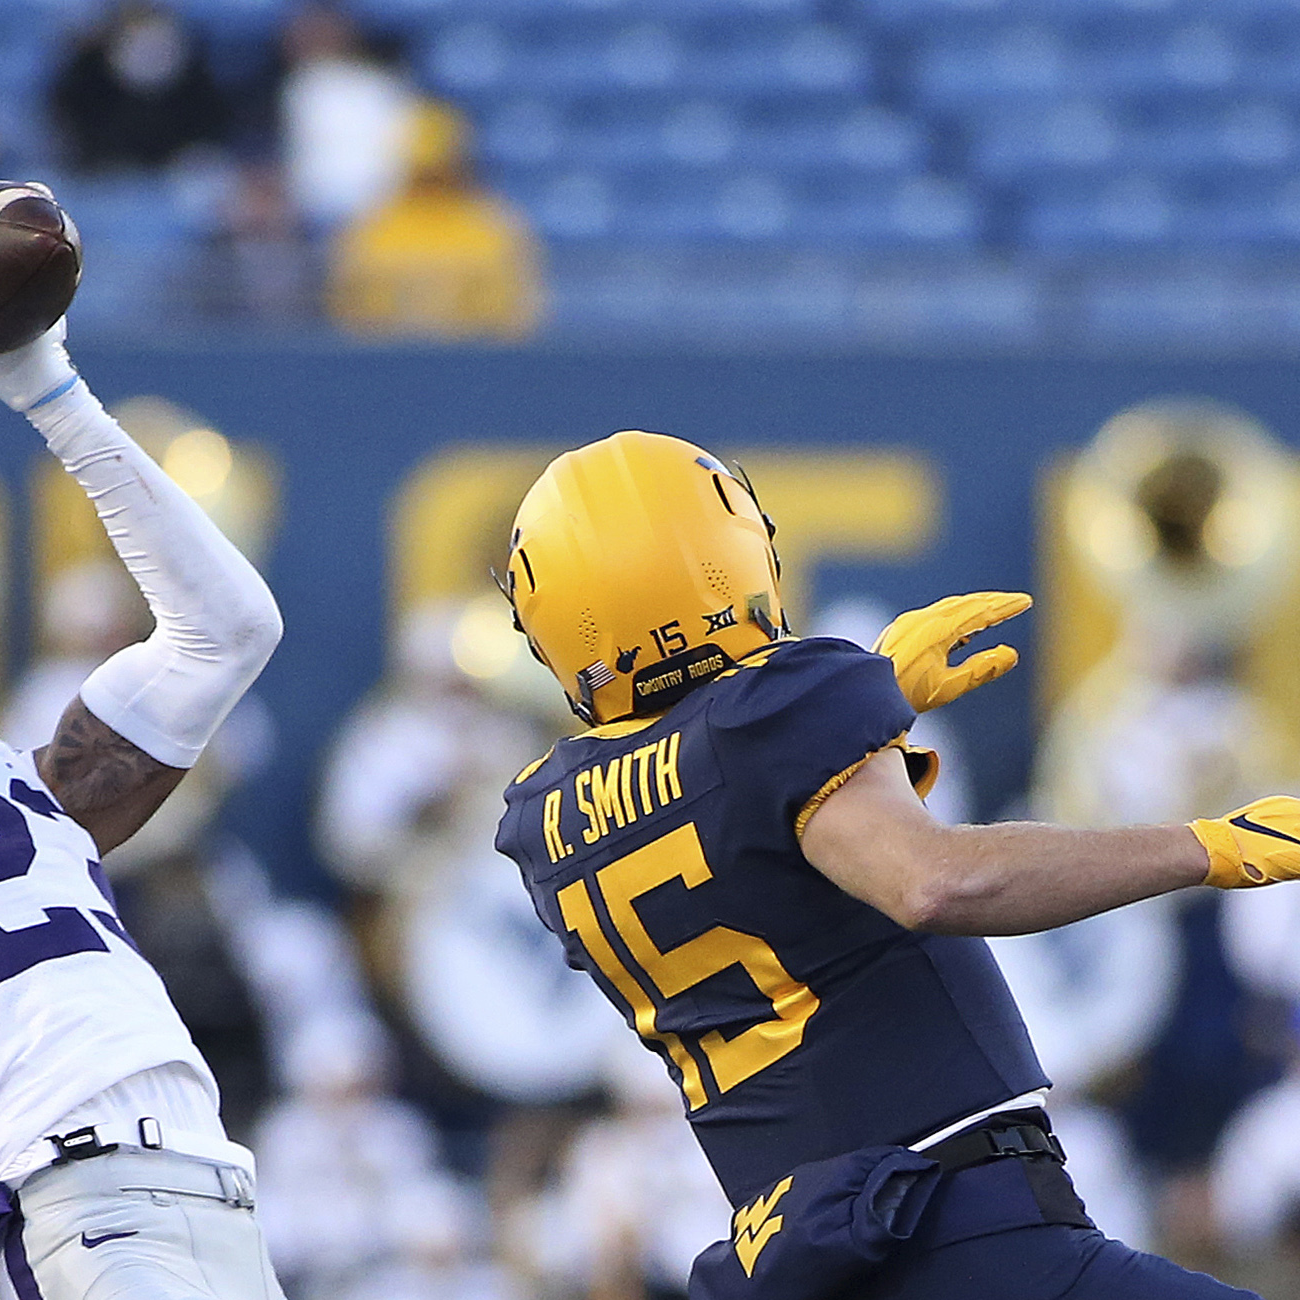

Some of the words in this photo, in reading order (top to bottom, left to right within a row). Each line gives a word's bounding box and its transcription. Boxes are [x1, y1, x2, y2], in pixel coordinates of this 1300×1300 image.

[636, 669, 683, 696] CUNTRY
[687, 653, 724, 679] ROADS
[649, 619, 689, 659] 15
[543, 789, 575, 864] R.
[575, 731, 683, 845] SMITH
[557, 821, 821, 1111] 15
